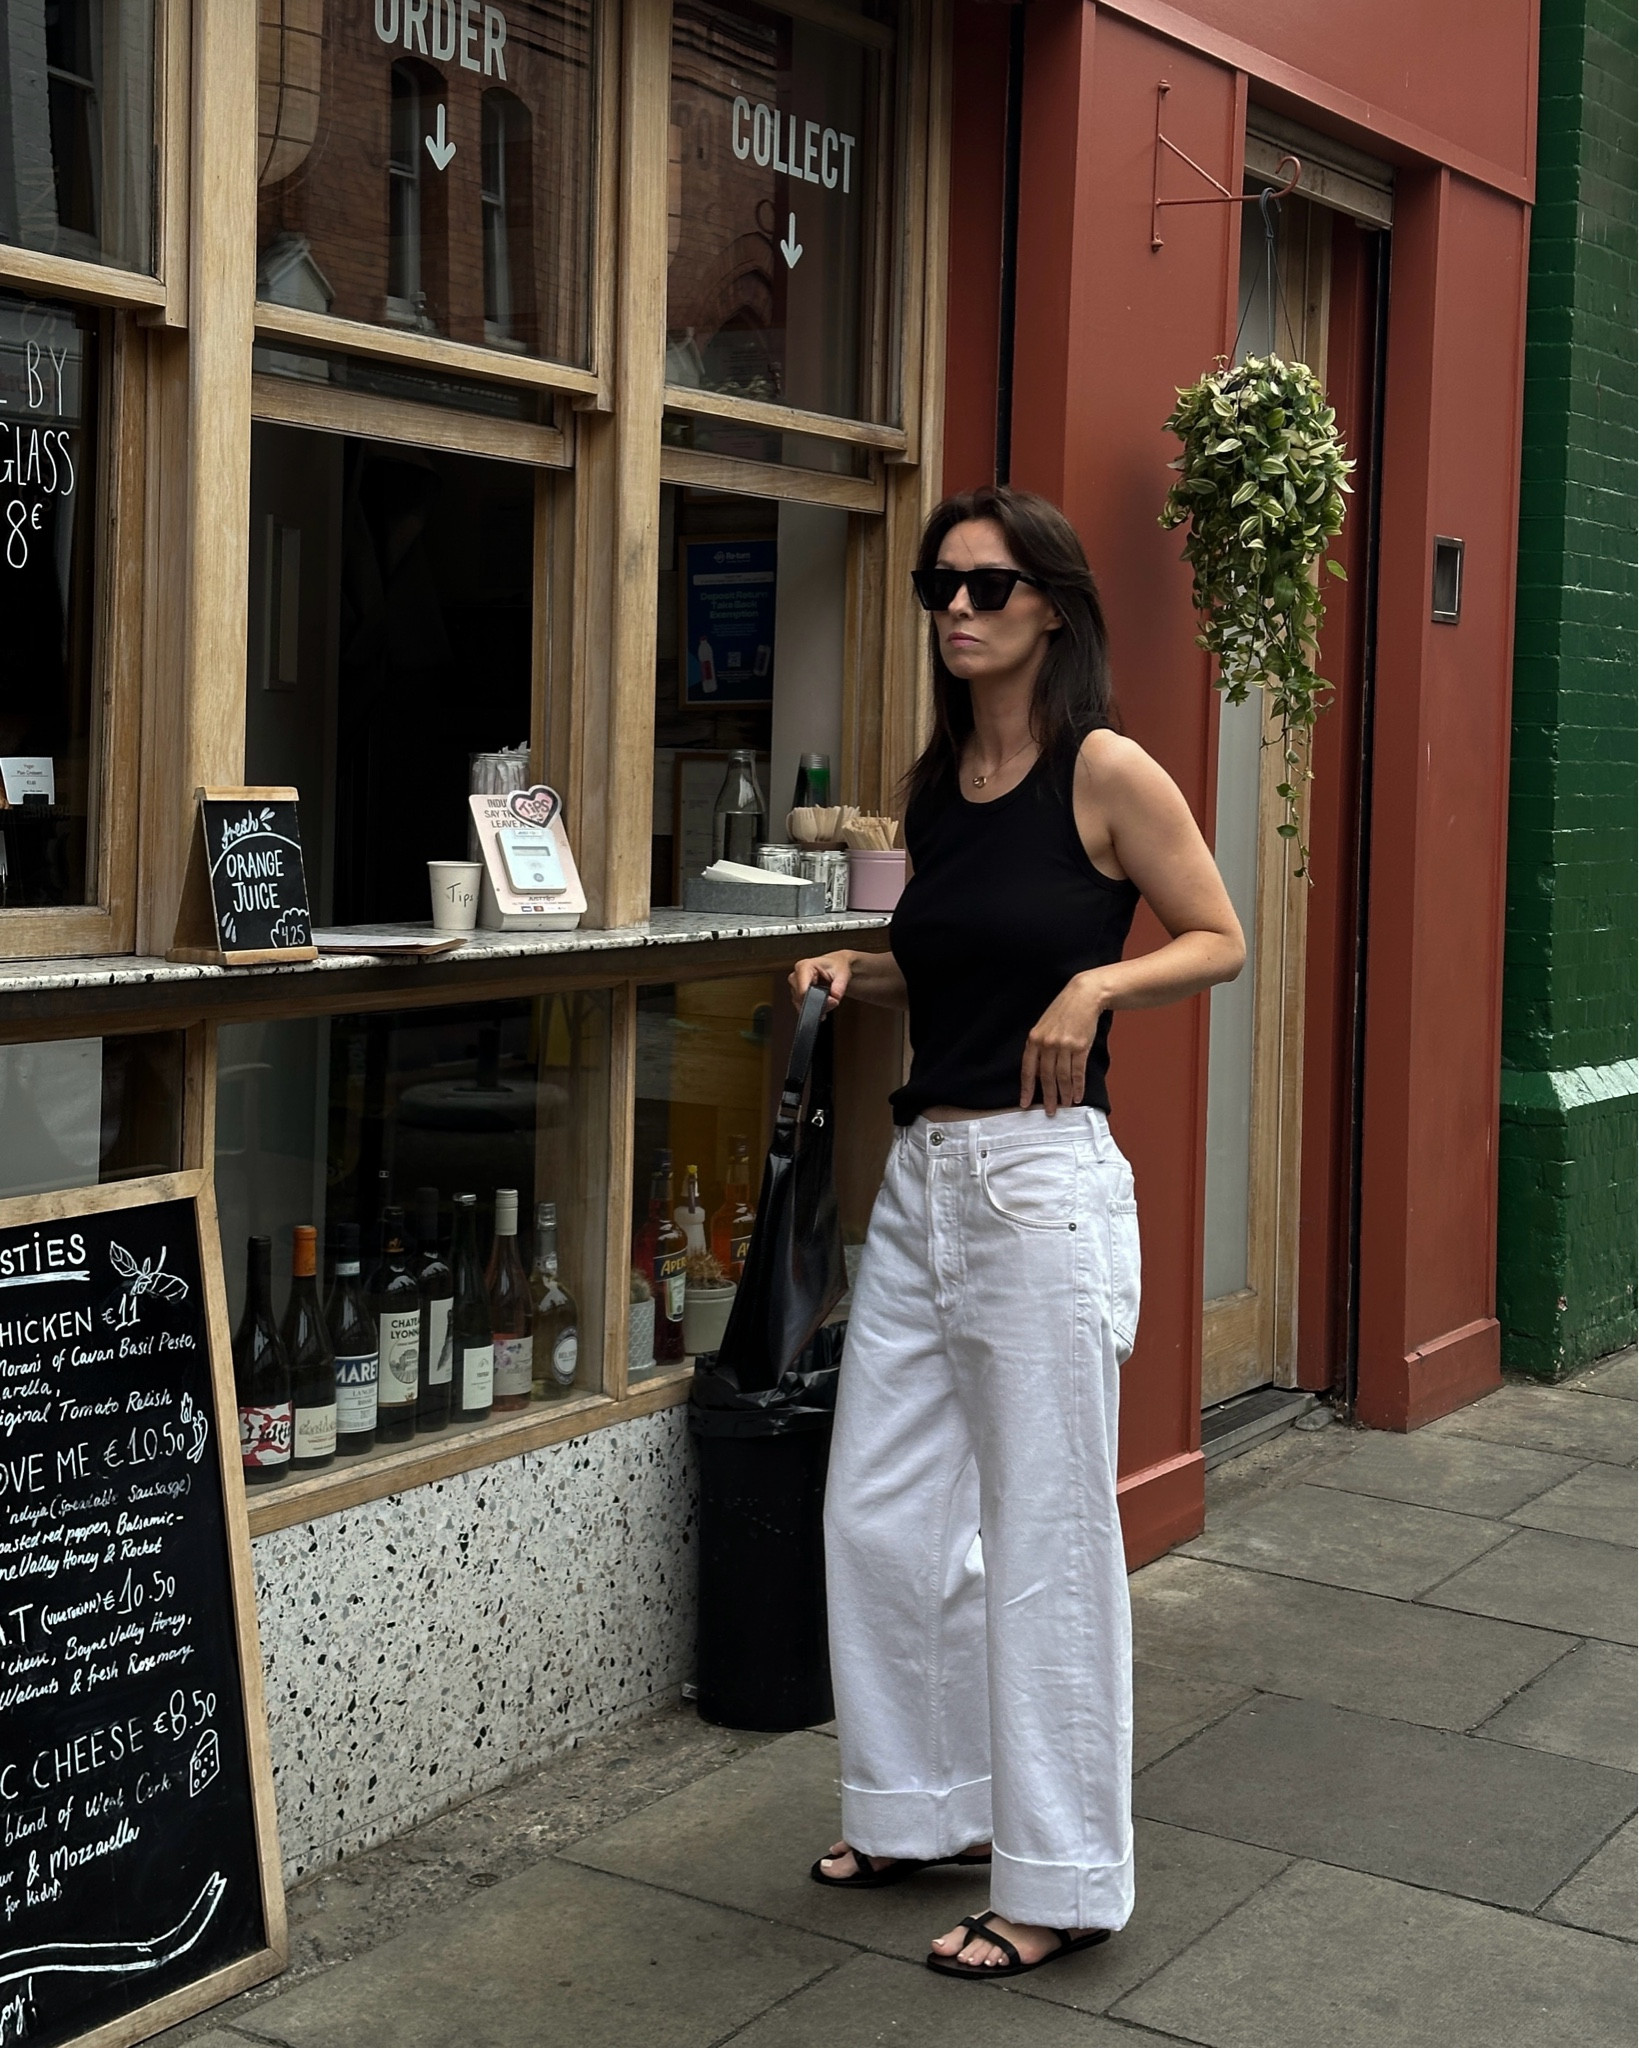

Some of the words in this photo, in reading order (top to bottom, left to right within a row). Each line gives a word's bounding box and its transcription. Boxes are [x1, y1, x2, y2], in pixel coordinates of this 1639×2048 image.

[375, 0, 507, 81] ORDER
[732, 96, 855, 193] COLLECT
[27, 340, 67, 415] BY
[484, 810, 500, 818] SAY
[491, 820, 518, 828] LEAVE
[226, 850, 284, 880] ORANGE
[232, 883, 280, 913] JUICE
[446, 882, 474, 907] Tips
[52, 1349, 66, 1372] of
[71, 1346, 114, 1366] Cavan
[119, 1336, 154, 1359] Basil
[59, 1399, 119, 1421] Tomato
[126, 1389, 172, 1413] Relish
[57, 1442, 91, 1484] ME
[19, 1552, 60, 1578] Valley
[63, 1549, 99, 1573] Honey
[103, 1543, 115, 1563] &
[120, 1537, 162, 1560] Rocket
[64, 1636, 108, 1662] Boyne
[109, 1625, 145, 1646] Valley
[0, 1678, 59, 1710] Walnuts
[70, 1668, 82, 1695] &
[87, 1663, 118, 1692] fresh
[127, 1644, 195, 1675] Rosemary
[0, 1764, 18, 1799] C
[33, 1717, 144, 1788] CHEESE
[5, 1806, 48, 1847] blend
[58, 1796, 75, 1831] of
[27, 1850, 40, 1887] &
[50, 1817, 140, 1878] Mozzarella
[5, 1895, 21, 1921] for
